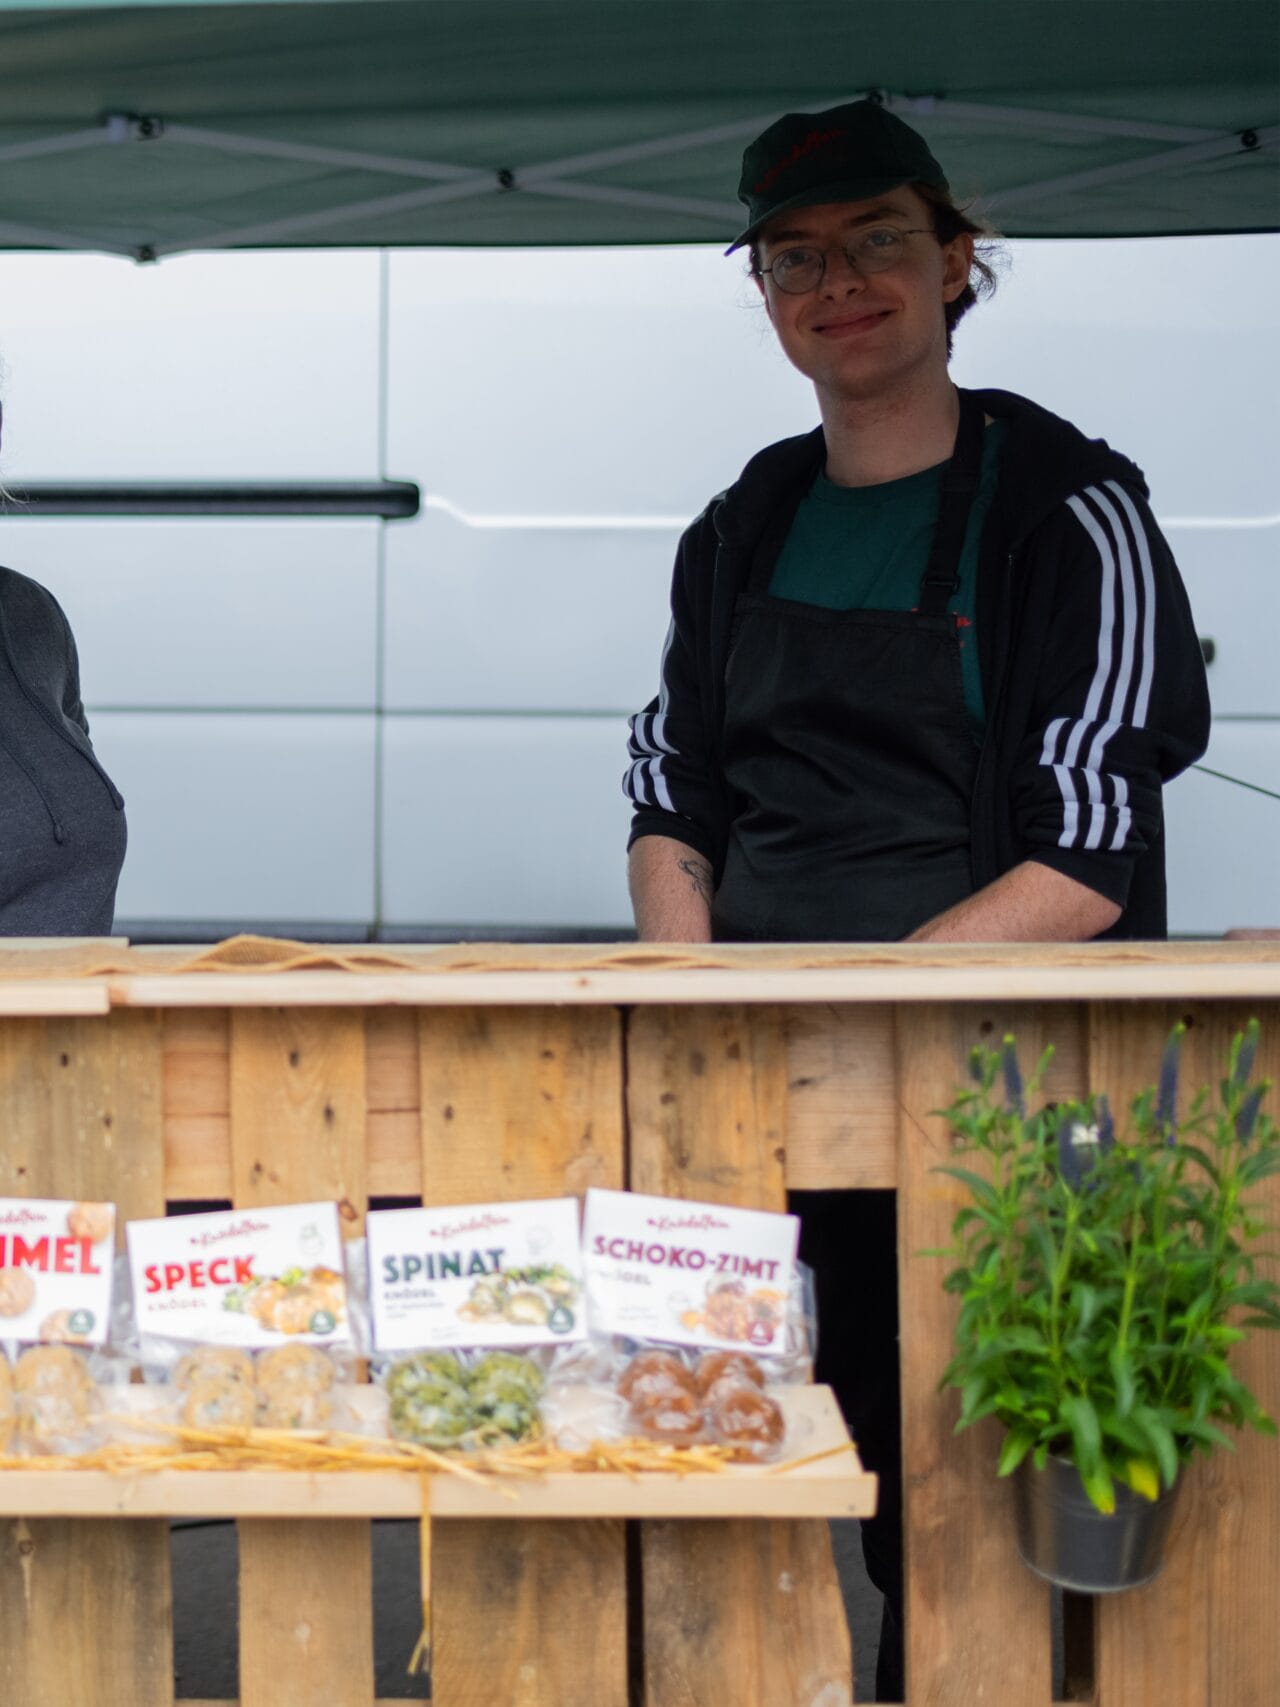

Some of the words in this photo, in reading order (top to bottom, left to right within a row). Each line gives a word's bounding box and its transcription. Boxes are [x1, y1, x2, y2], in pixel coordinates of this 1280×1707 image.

[144, 1253, 257, 1293] SPECK
[382, 1247, 506, 1284] SPINAT
[592, 1235, 781, 1281] SCHOKO-ZIMT
